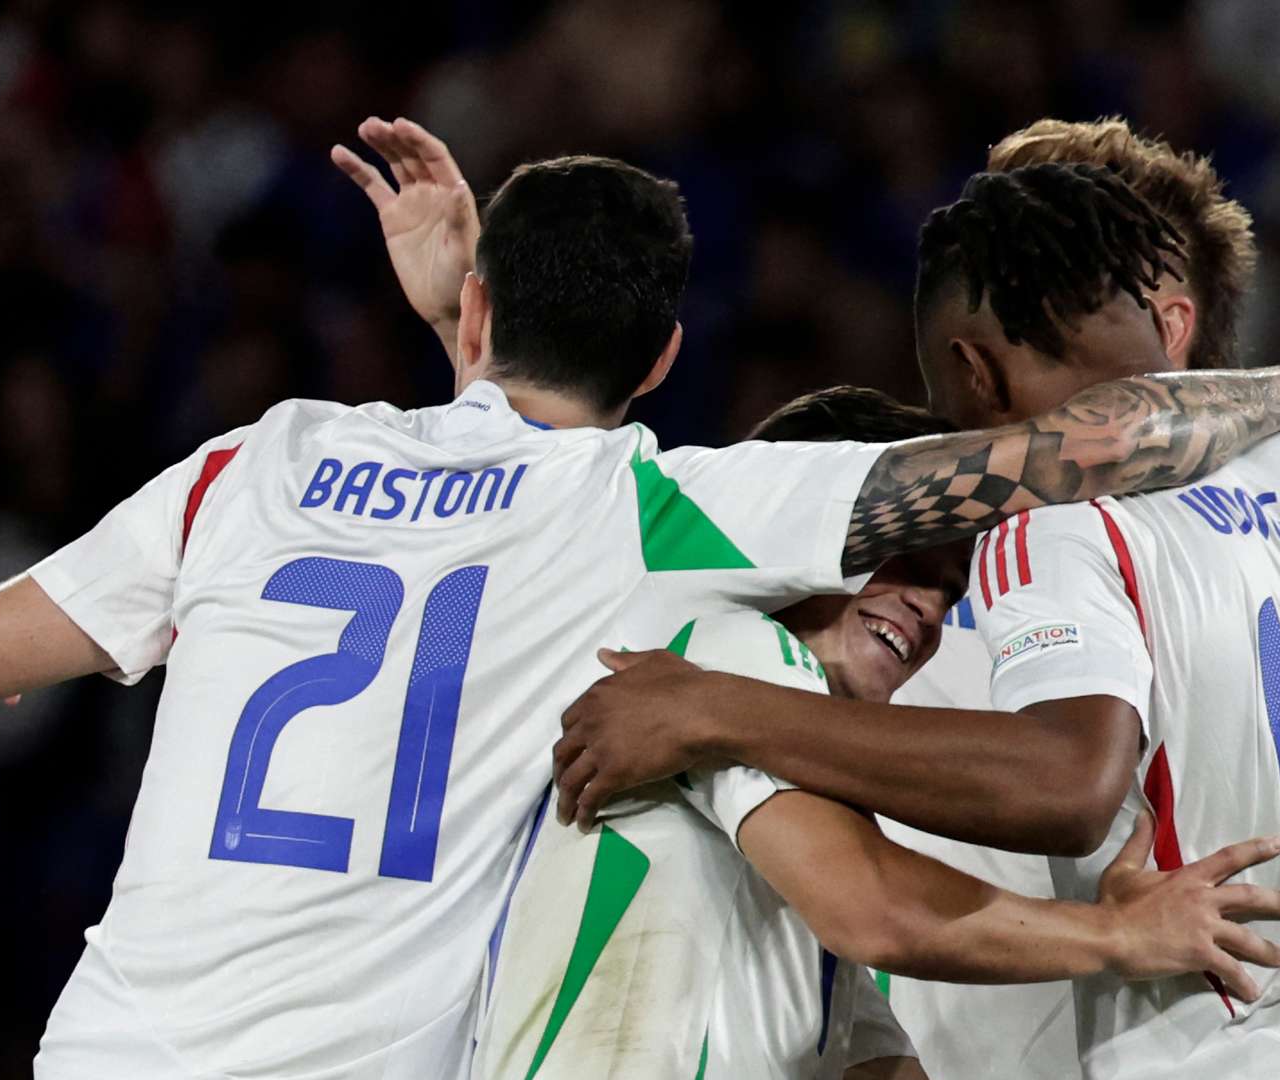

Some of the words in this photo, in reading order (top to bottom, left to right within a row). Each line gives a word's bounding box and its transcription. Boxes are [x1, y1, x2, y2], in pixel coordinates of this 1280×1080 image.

[300, 458, 527, 522] BASTONI
[995, 627, 1078, 664] NDATION
[207, 555, 490, 883] 21
